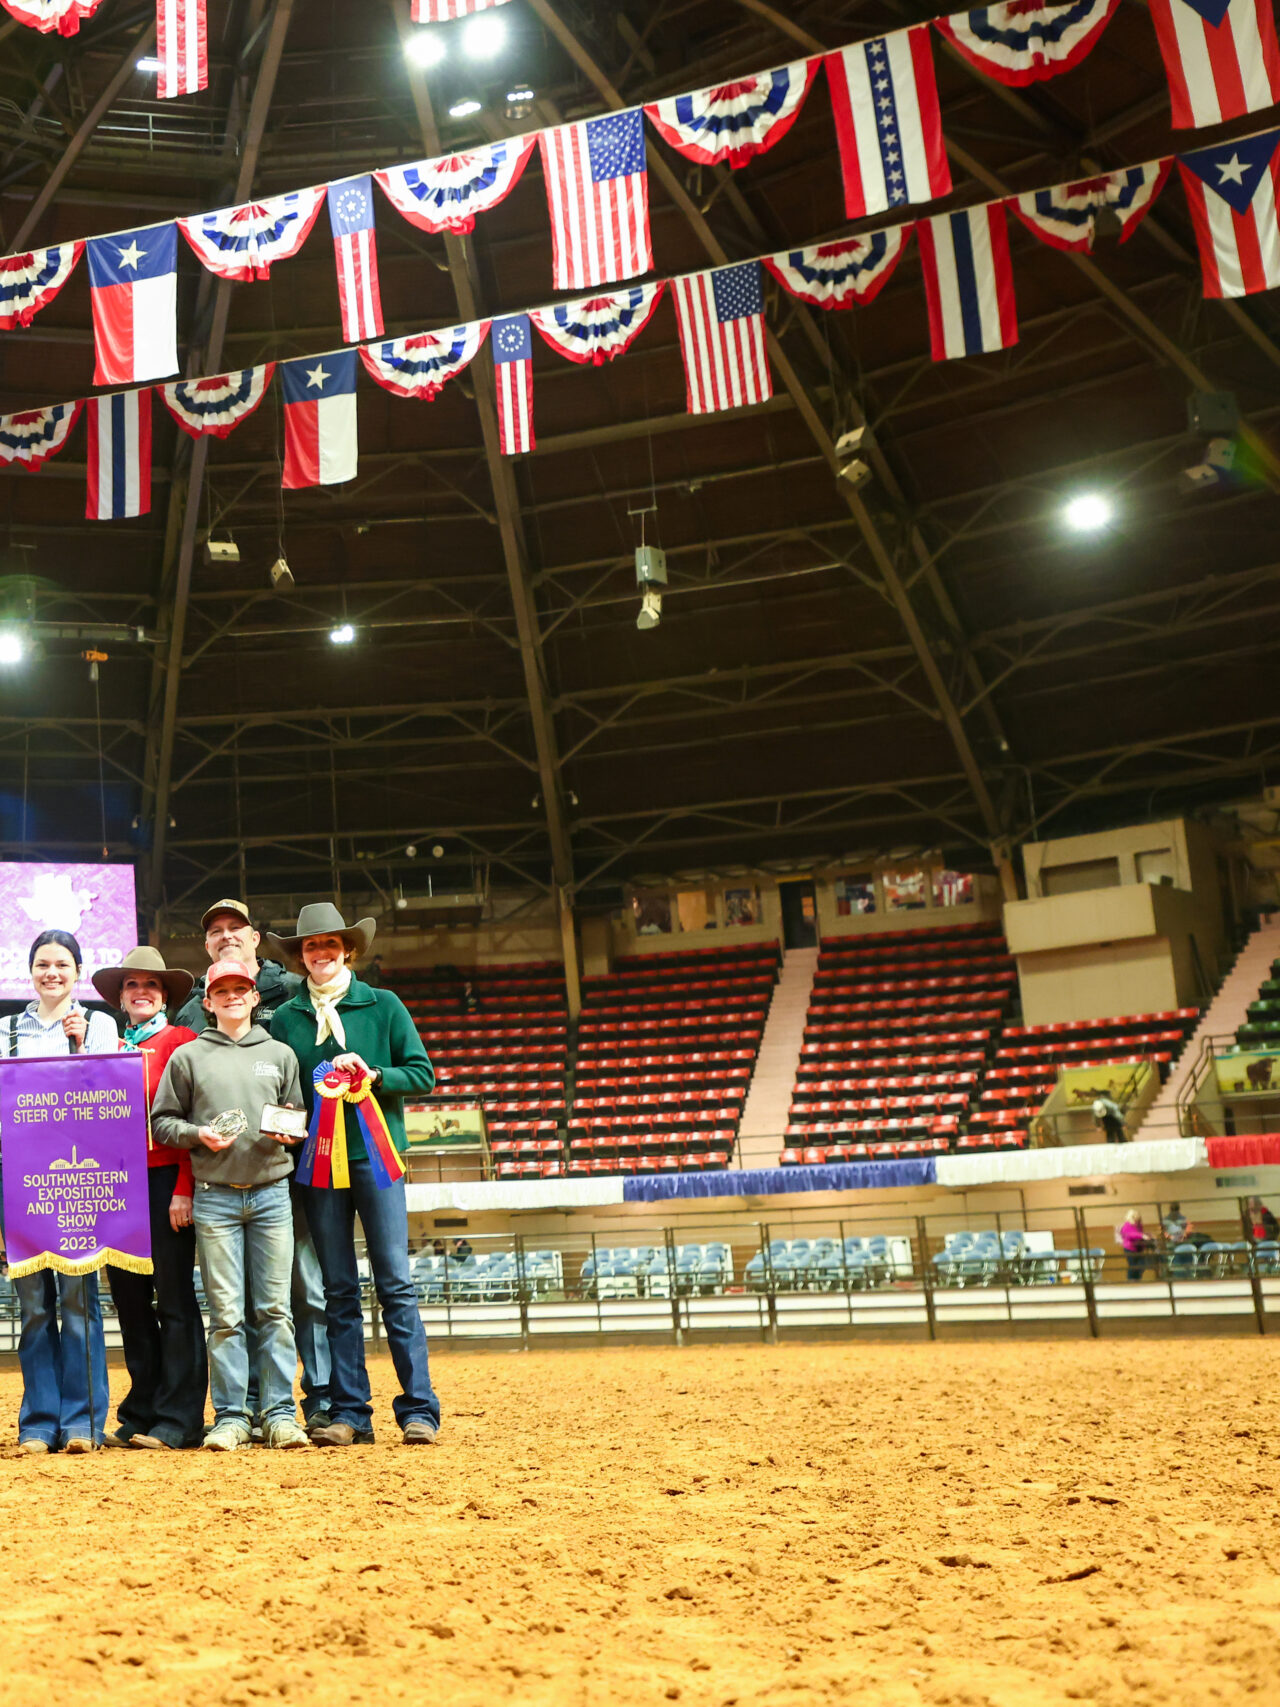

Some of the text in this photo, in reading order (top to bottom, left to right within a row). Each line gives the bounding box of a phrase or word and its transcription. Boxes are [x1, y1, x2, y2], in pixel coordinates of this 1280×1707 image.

[17, 1089, 127, 1108] GRAND CHAMPION
[13, 1105, 132, 1124] STEER OF THE SHOW
[23, 1170, 129, 1188] SOUTHWESTERN
[38, 1185, 114, 1201] EXPOSITION
[26, 1198, 127, 1215] AND LIVESTOCK
[57, 1214, 98, 1228] SHOW
[59, 1236, 98, 1251] 2023
